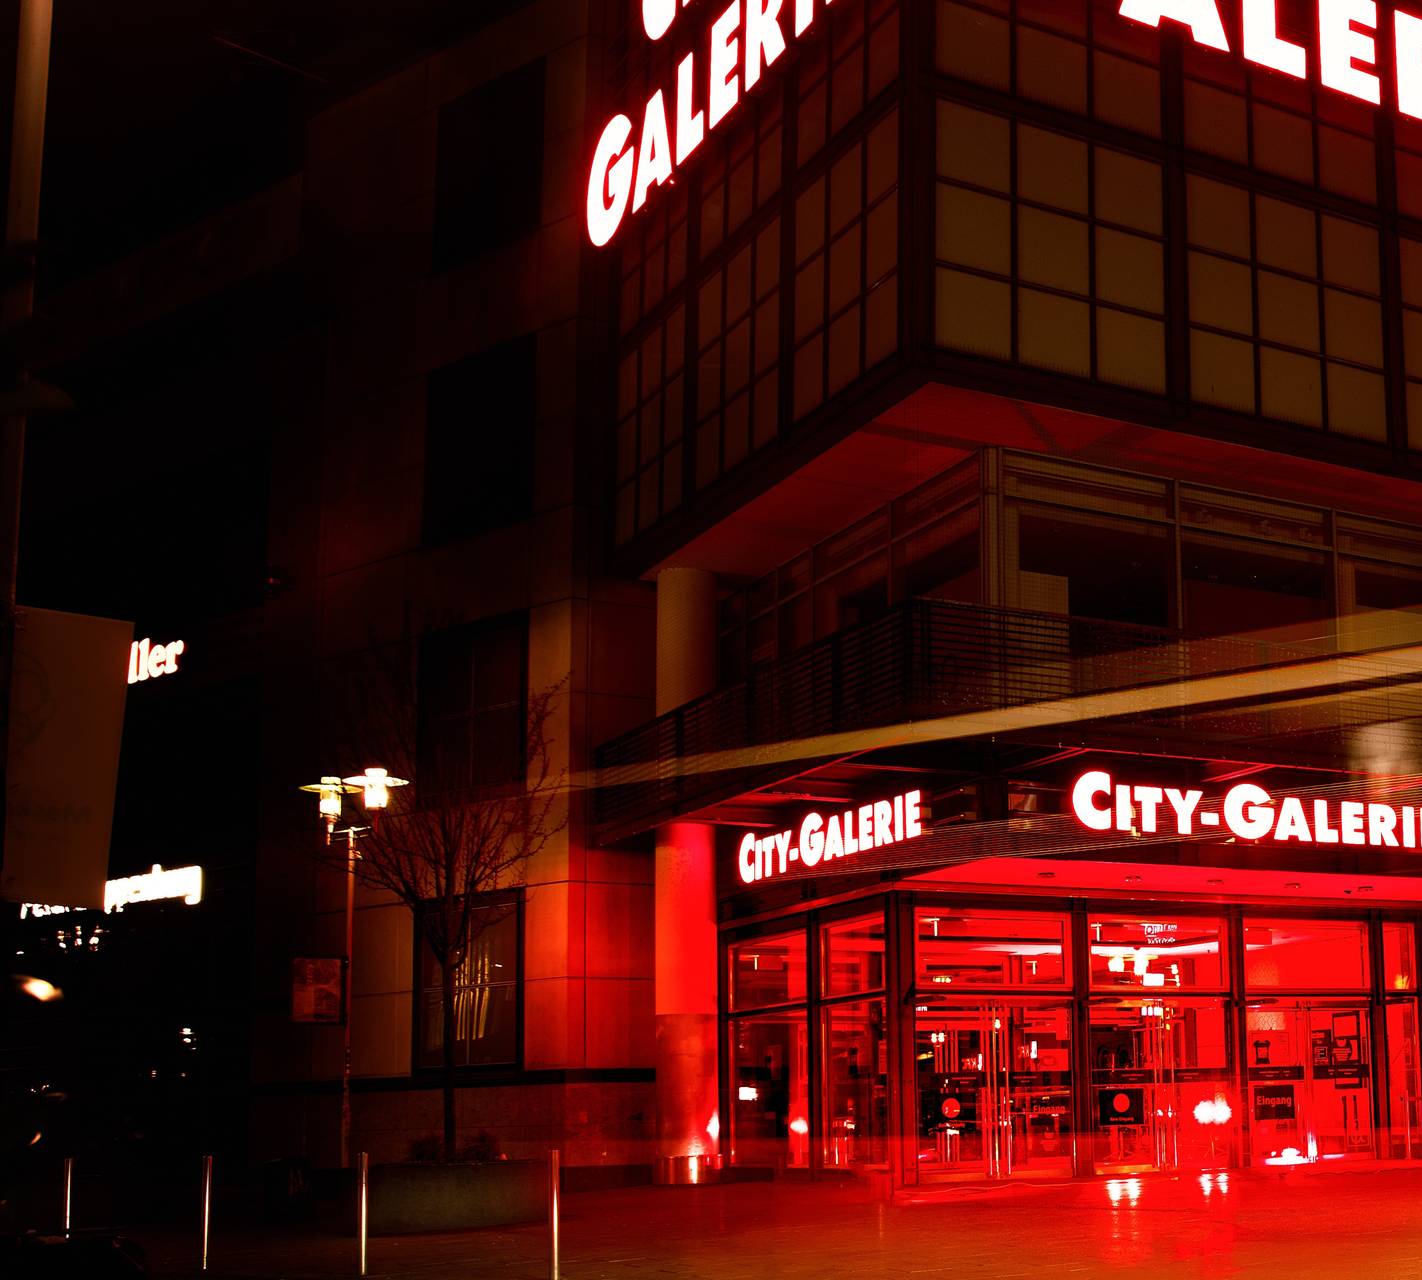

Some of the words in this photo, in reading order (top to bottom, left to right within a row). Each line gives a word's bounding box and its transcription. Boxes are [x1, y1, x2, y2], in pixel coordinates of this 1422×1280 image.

[587, 0, 833, 246] GALER
[738, 789, 922, 884] CITY-GALERIE
[1256, 1095, 1292, 1108] Eingang
